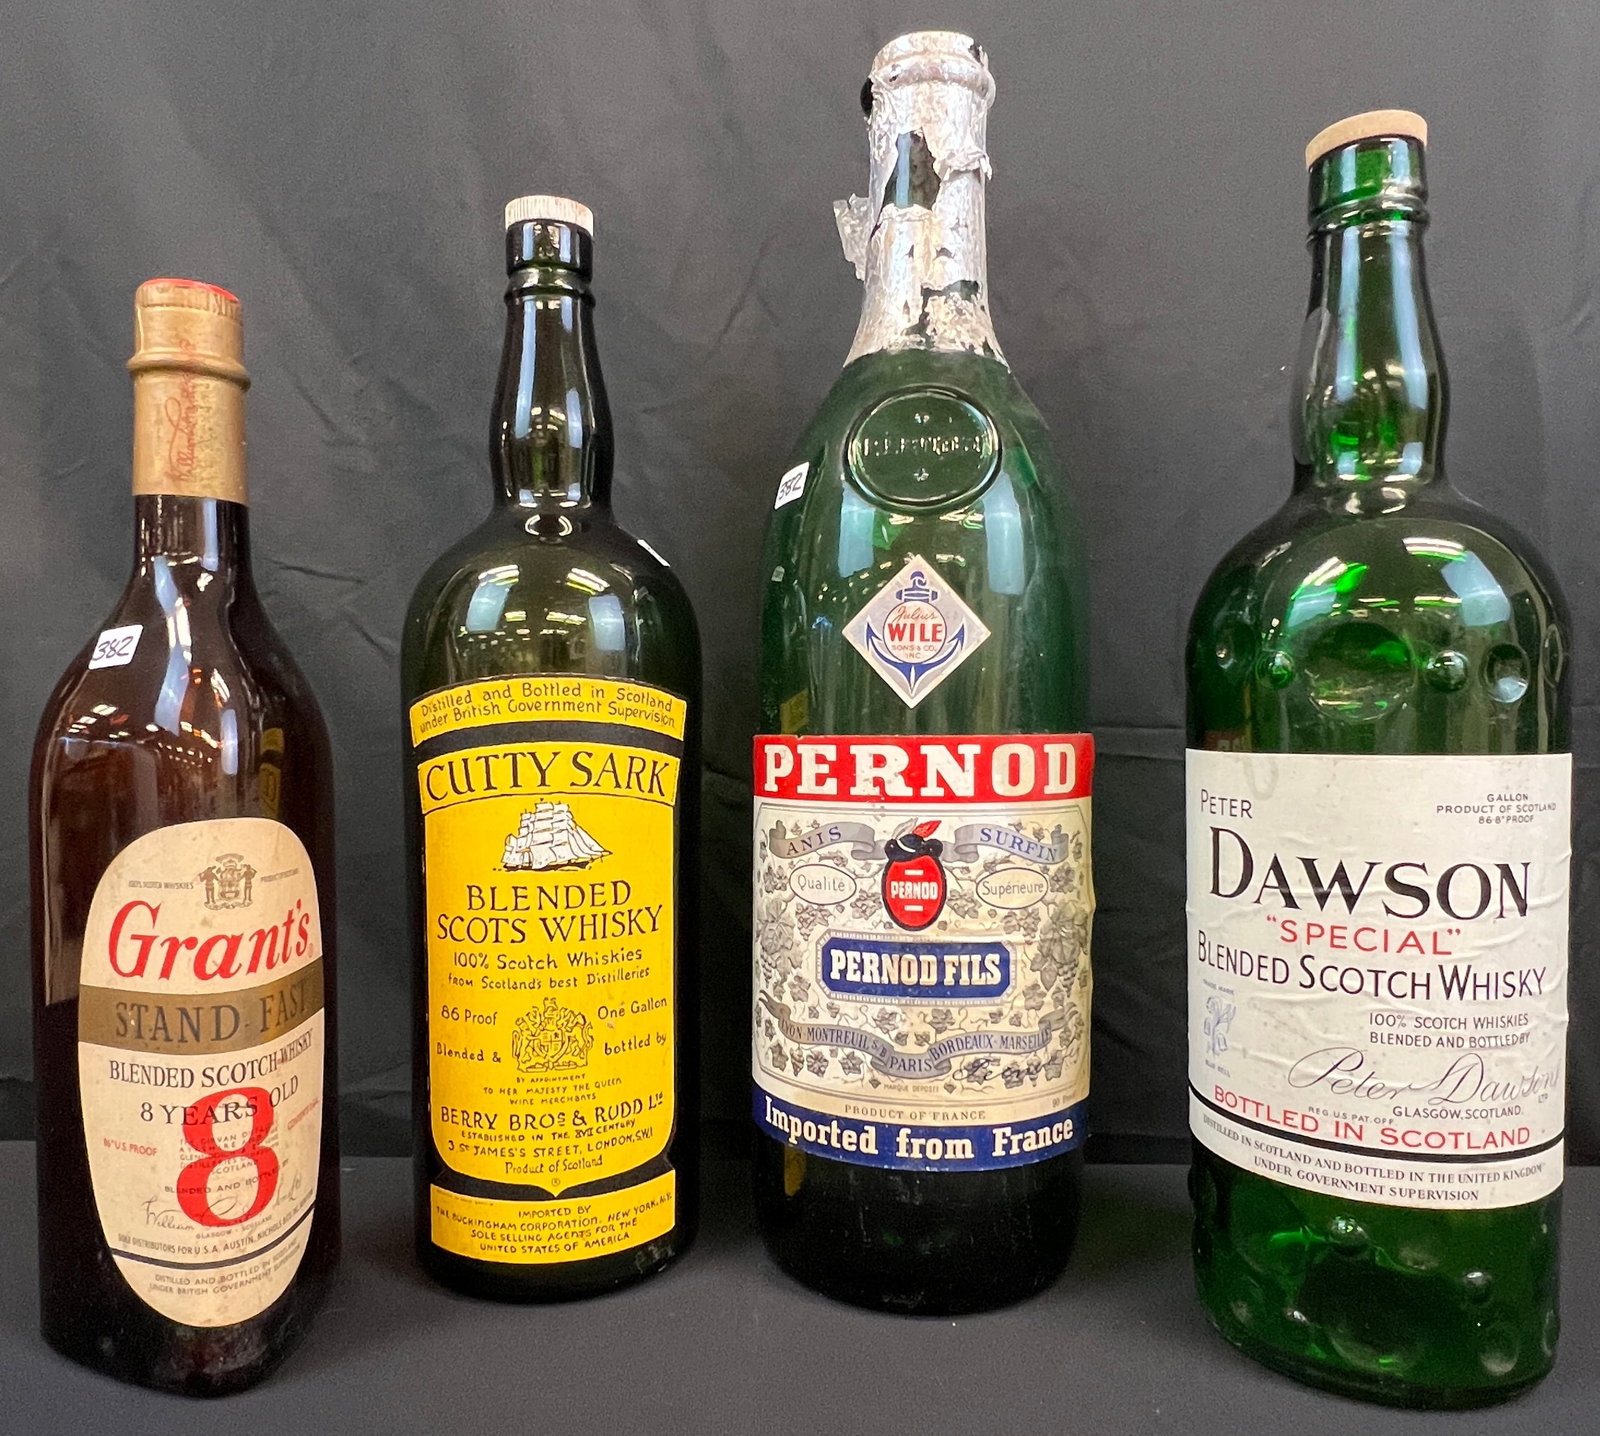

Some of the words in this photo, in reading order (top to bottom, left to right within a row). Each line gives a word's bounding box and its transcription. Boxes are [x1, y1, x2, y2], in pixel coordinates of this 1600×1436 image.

[888, 624, 943, 643] WILE
[93, 636, 133, 661] 382
[421, 691, 473, 717] Distilled
[483, 685, 512, 700] and
[522, 683, 581, 697] Bottled
[592, 683, 604, 698] in
[617, 687, 673, 712] Scotland
[420, 714, 448, 733] under
[454, 703, 500, 721] British
[508, 700, 602, 713] Government
[608, 701, 675, 728] Supervision
[426, 751, 560, 801] CUTTY
[570, 751, 670, 796] SARK
[764, 743, 1077, 797] PERNOD
[1201, 789, 1253, 818] PETER
[1437, 805, 1495, 813] PRODUCT
[1499, 804, 1513, 813] OF
[1516, 802, 1556, 813] SCOTLAND
[1487, 793, 1529, 802] GALLON
[1506, 814, 1535, 824] PROOF
[787, 826, 842, 855] ANIS
[980, 828, 1058, 862] SURFIN
[1210, 826, 1531, 921] DAWSON
[467, 880, 631, 912] BLENDED
[798, 876, 846, 893] Qualité
[982, 879, 1044, 897] Supérieure
[891, 881, 938, 900] PERNOD
[437, 914, 527, 943] SCOTS
[540, 904, 663, 942] WHISKY
[109, 899, 310, 980] Grant's
[453, 952, 489, 969] 100%
[497, 955, 558, 970] Scotch
[568, 948, 642, 968] Whiskies
[830, 948, 938, 986] PERNOD
[943, 953, 1002, 986] FILS
[1198, 930, 1290, 985] BLENDED
[1299, 954, 1431, 1000] SCOTCH
[1439, 964, 1546, 1001] WHISKY
[482, 977, 542, 990] Scotland's
[549, 977, 578, 989] best
[587, 966, 650, 985] Distilleries
[116, 1002, 240, 1043] STAND
[259, 982, 308, 1033] FAST
[441, 1005, 460, 1021] 86
[464, 1011, 498, 1025] Proof
[597, 1005, 625, 1020] One
[631, 997, 667, 1015] Gallon
[1370, 1012, 1406, 1028] 100%
[1414, 1016, 1469, 1030] SCOTCH
[1473, 1013, 1529, 1030] WHISKIES
[604, 1037, 650, 1056] bottled
[656, 1033, 666, 1045] by
[807, 1027, 869, 1049] MONTREUIL
[929, 1034, 993, 1061] BORDEAUX
[1000, 1028, 1051, 1049] MARSEILLE
[1370, 1032, 1432, 1047] BLENDED
[1437, 1034, 1465, 1048] AND
[1469, 1033, 1519, 1049] BOTTLED
[436, 1042, 484, 1062] Blended
[492, 1051, 502, 1063] &
[888, 1054, 934, 1072] PARIS
[109, 1060, 195, 1089] BLENDED
[201, 1054, 277, 1088] SCOTCH
[1288, 1046, 1410, 1100] Peter
[141, 1102, 152, 1121] 8
[160, 1096, 258, 1126] YEARS
[270, 1075, 299, 1108] OLD
[484, 1087, 493, 1095] TO
[499, 1088, 518, 1096] HER
[526, 1086, 567, 1094] MAJESTY
[573, 1082, 591, 1091] THE
[441, 1106, 498, 1131] BERRY
[572, 1113, 587, 1126] &
[595, 1099, 643, 1124] RUDD
[845, 1105, 904, 1120] PRODUCT
[910, 1111, 925, 1120] OF
[932, 1110, 986, 1121] FRANCE
[1214, 1084, 1319, 1133] BOTTLED
[1335, 1120, 1363, 1141] IN
[1380, 1127, 1531, 1150] SCOTLAND
[461, 1131, 525, 1141] ESTABLISHED
[552, 1131, 569, 1140] THE
[765, 1095, 878, 1155] Imported
[896, 1127, 974, 1160] from
[992, 1118, 1074, 1157] France
[129, 1143, 158, 1156] PROOF
[176, 1087, 280, 1227] 8
[448, 1140, 454, 1151] 3
[474, 1145, 526, 1158] JAMES'S
[1203, 1114, 1239, 1141] DISTILLED
[1241, 1135, 1252, 1148] IN
[1254, 1139, 1312, 1165] SCOTLAND
[1315, 1157, 1341, 1171] AND
[1345, 1163, 1405, 1181] BOTTLED
[1410, 1171, 1424, 1182] IN
[1429, 1172, 1455, 1183] THE
[1458, 1168, 1500, 1184] UNITED
[1503, 1164, 1544, 1181] KINGDOM
[505, 1161, 543, 1174] Product
[549, 1159, 558, 1173] of
[563, 1155, 603, 1171] Scotland
[216, 1182, 241, 1192] AND
[1254, 1156, 1293, 1178] UNDER
[1297, 1168, 1386, 1196] GOVERNMENT
[1389, 1186, 1479, 1201] SUPERVISION
[519, 1208, 571, 1219] IMPORTED
[578, 1205, 591, 1215] BY
[608, 1209, 631, 1221] NEW
[471, 1229, 496, 1240] SOLE
[501, 1233, 542, 1242] SELLING
[548, 1229, 591, 1240] AGENTS
[596, 1223, 614, 1233] FOR
[619, 1218, 637, 1229] THE
[178, 1244, 192, 1254] FOR
[480, 1243, 516, 1253] UNITED
[521, 1243, 560, 1254] STATES
[564, 1242, 578, 1251] OF
[585, 1233, 629, 1248] AMERICA
[195, 1276, 216, 1285] AND
